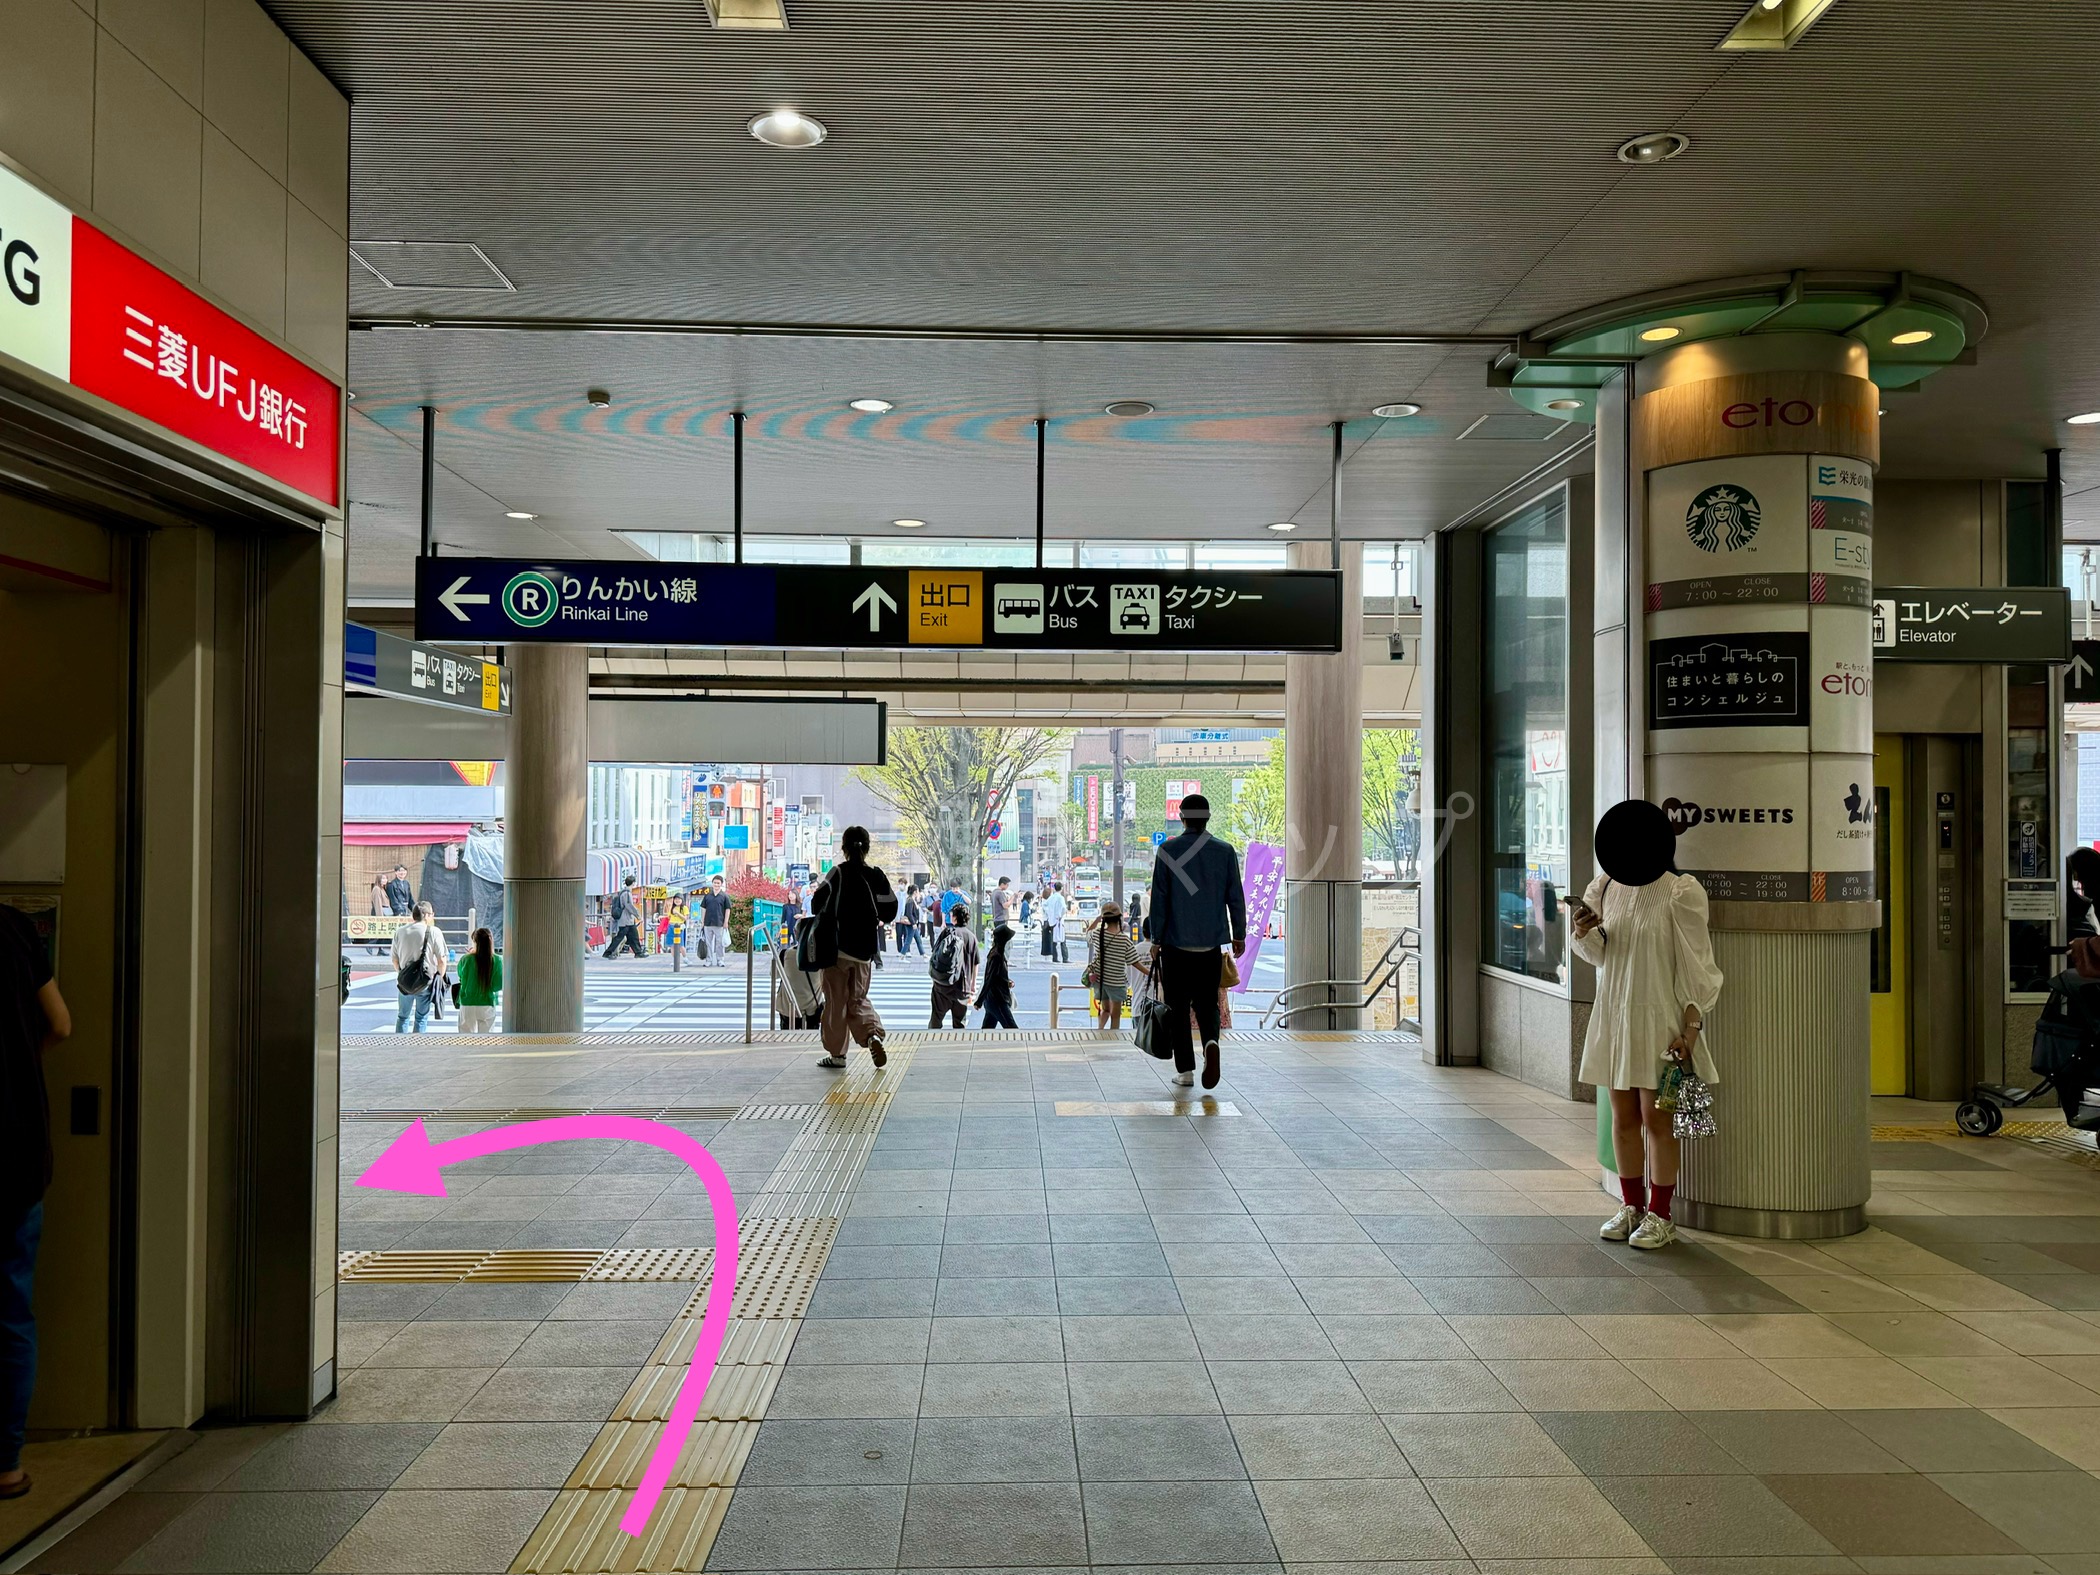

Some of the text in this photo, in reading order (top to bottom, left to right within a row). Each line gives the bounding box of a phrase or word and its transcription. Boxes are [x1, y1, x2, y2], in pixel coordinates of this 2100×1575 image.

[123, 306, 308, 450] 三菱UFJ銀行
[561, 575, 698, 604] りんかい線
[1690, 578, 1772, 590] OPEN CLOSE
[521, 588, 540, 611] R
[920, 582, 971, 609] 出口
[1050, 585, 1099, 609] バス
[1114, 587, 1156, 600] TAXI
[1165, 585, 1264, 609] タクシー
[1737, 587, 1779, 598] 22:00
[561, 606, 649, 622] Rinkai Line
[920, 613, 948, 627] Exit
[1900, 601, 2043, 625] エレベーター
[1049, 614, 1079, 629] Bus
[1165, 614, 1196, 630] Taxi
[1900, 629, 1957, 643] Elevator
[427, 655, 441, 675] バス
[444, 660, 456, 672] TAXI
[457, 663, 481, 682] タクシー
[427, 678, 436, 688] Bus
[1667, 671, 1784, 688] 住まいと暮らしの
[457, 682, 465, 693] Taxi
[1667, 692, 1784, 707] コンシェルジュ
[1667, 808, 1794, 824] MY SWEETS
[1755, 880, 1787, 888] 22:00
[1846, 876, 1859, 884] OPEN
[1706, 889, 1732, 897] 0:00
[1756, 889, 1787, 897] 19:00
